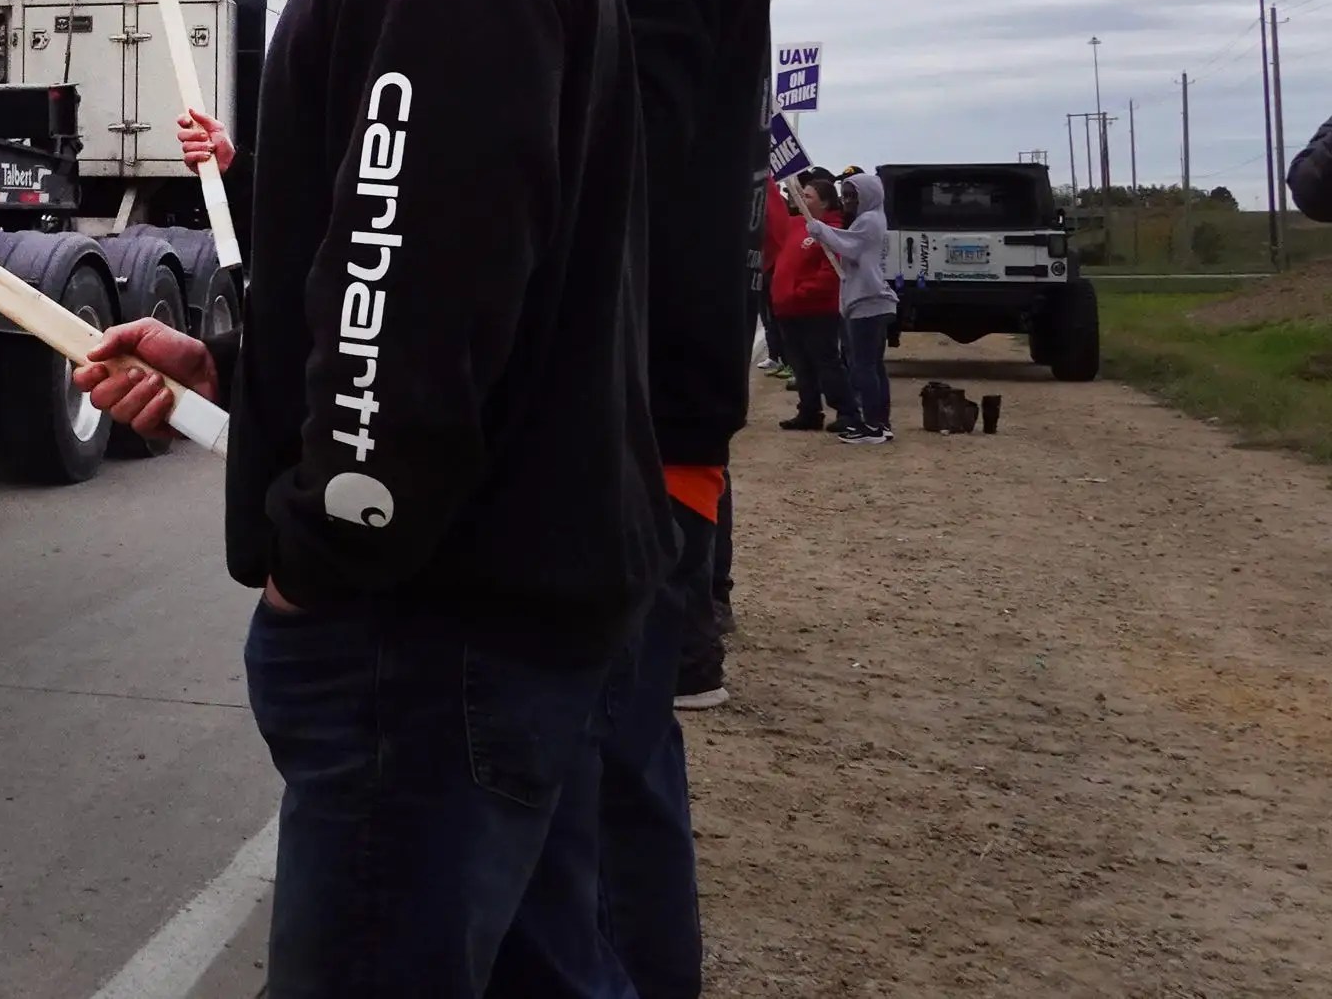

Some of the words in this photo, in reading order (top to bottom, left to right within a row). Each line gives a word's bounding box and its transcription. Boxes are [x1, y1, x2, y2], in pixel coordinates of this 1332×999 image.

[779, 48, 819, 66] UAW
[789, 70, 806, 88] ON
[777, 83, 817, 108] STRIKE
[769, 135, 801, 177] RIKE
[0, 162, 33, 187] Talbert
[332, 71, 413, 462] carhartt
